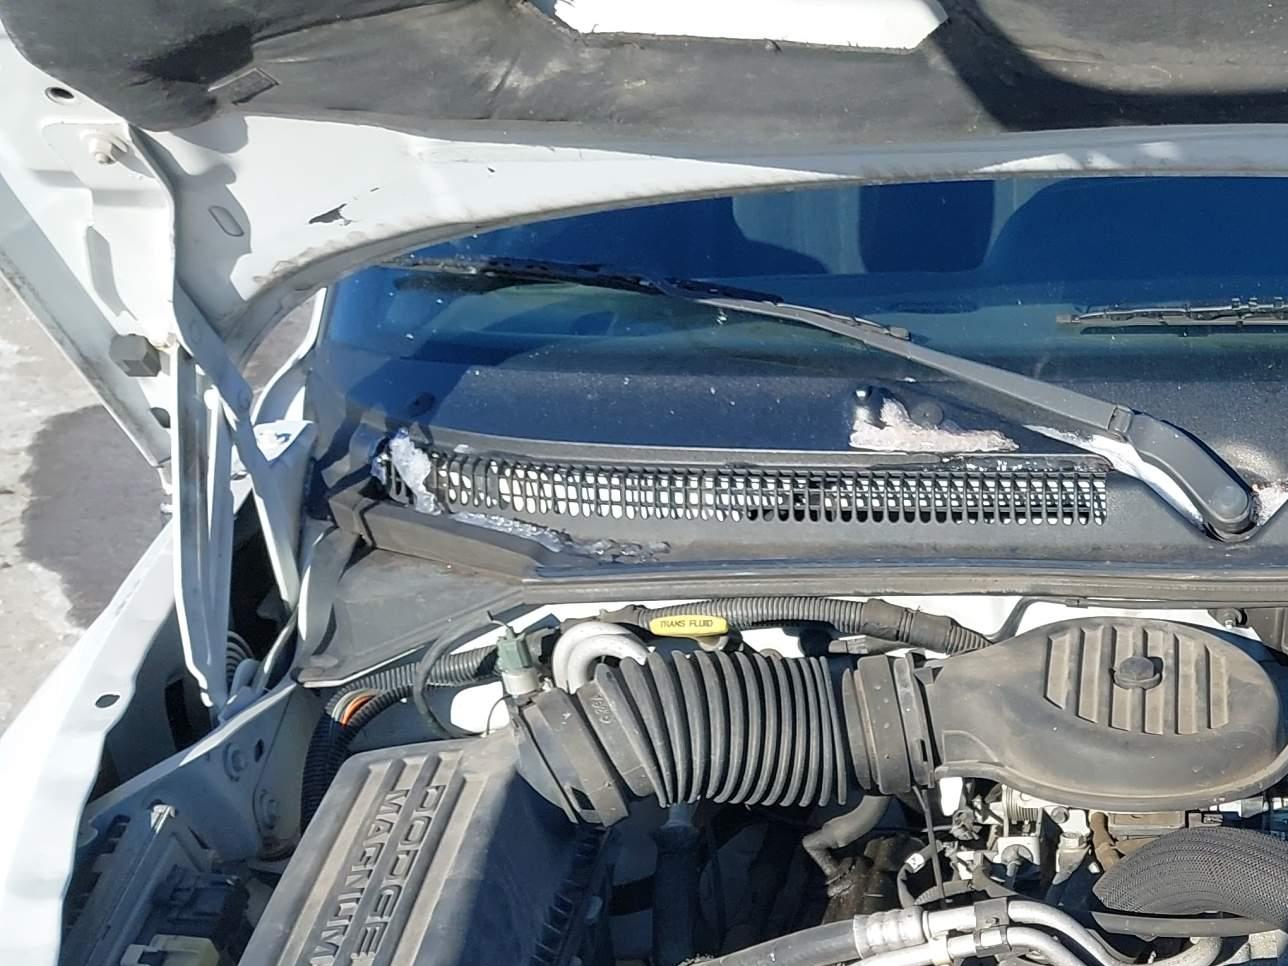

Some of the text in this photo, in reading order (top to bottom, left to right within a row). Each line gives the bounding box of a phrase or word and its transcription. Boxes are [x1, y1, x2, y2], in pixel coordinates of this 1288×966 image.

[660, 619, 713, 628] TRANS FLUID
[350, 784, 449, 960] DODGE
